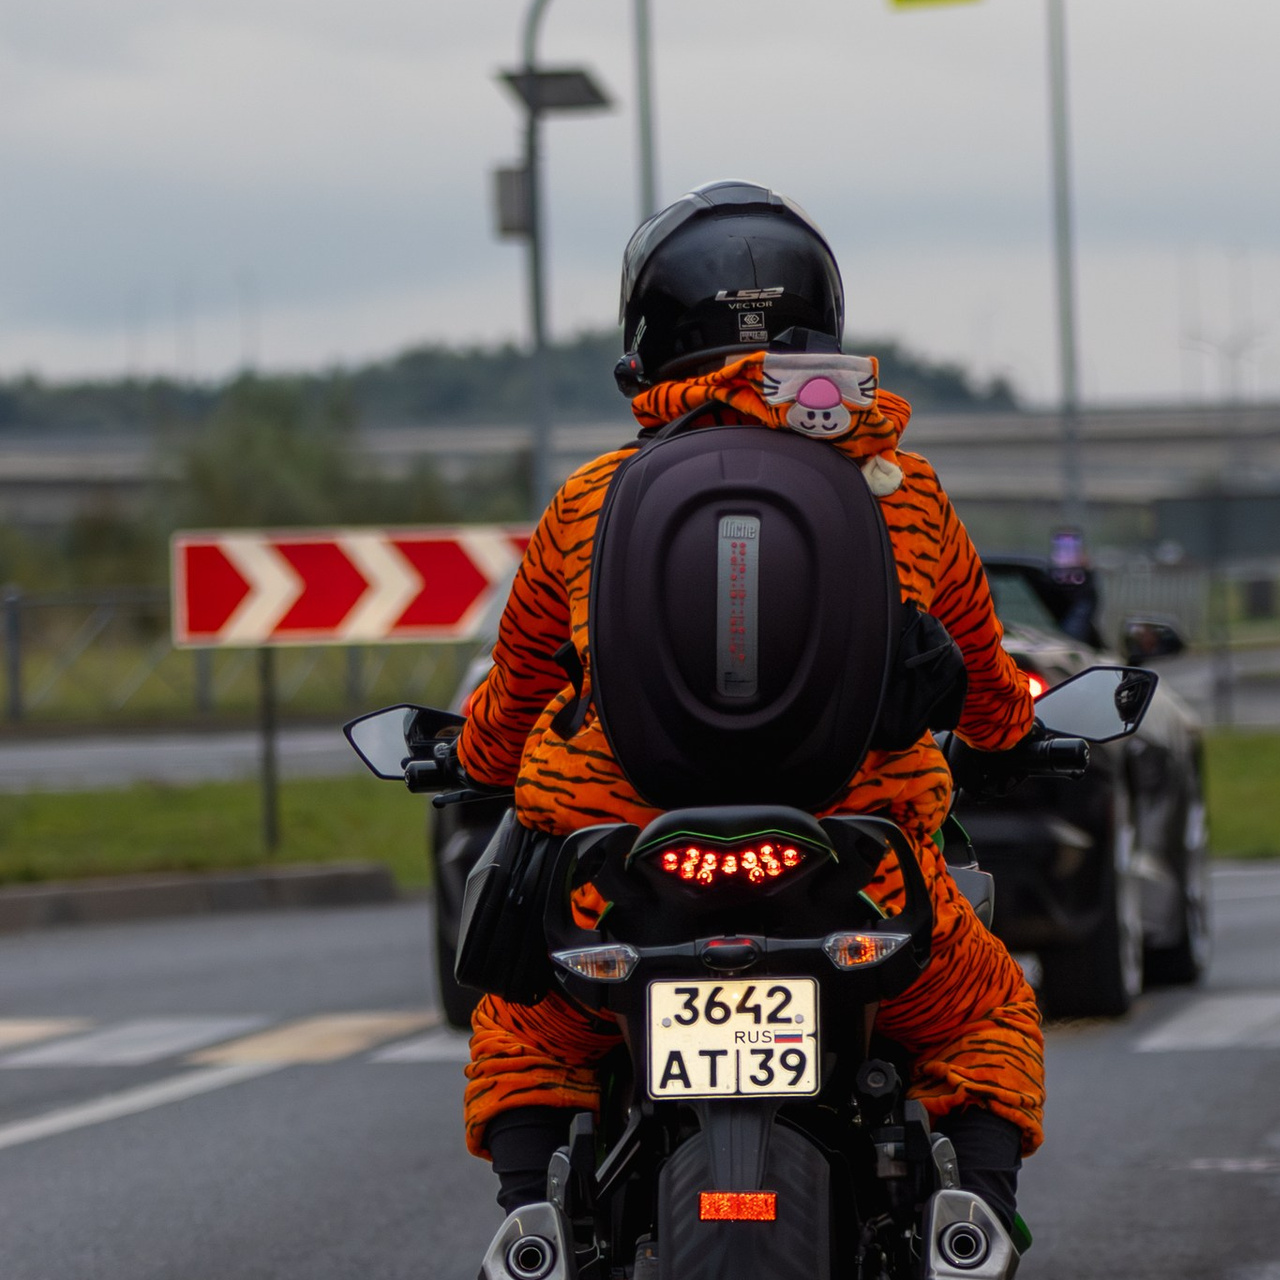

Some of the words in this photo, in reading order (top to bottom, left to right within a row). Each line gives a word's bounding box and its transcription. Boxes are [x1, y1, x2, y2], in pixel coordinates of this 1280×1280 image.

[715, 287, 784, 301] LS2
[728, 301, 773, 310] VECTOR
[674, 986, 792, 1025] 3642
[734, 1030, 773, 1044] RUS
[659, 1049, 728, 1089] AT
[750, 1048, 807, 1087] 39
